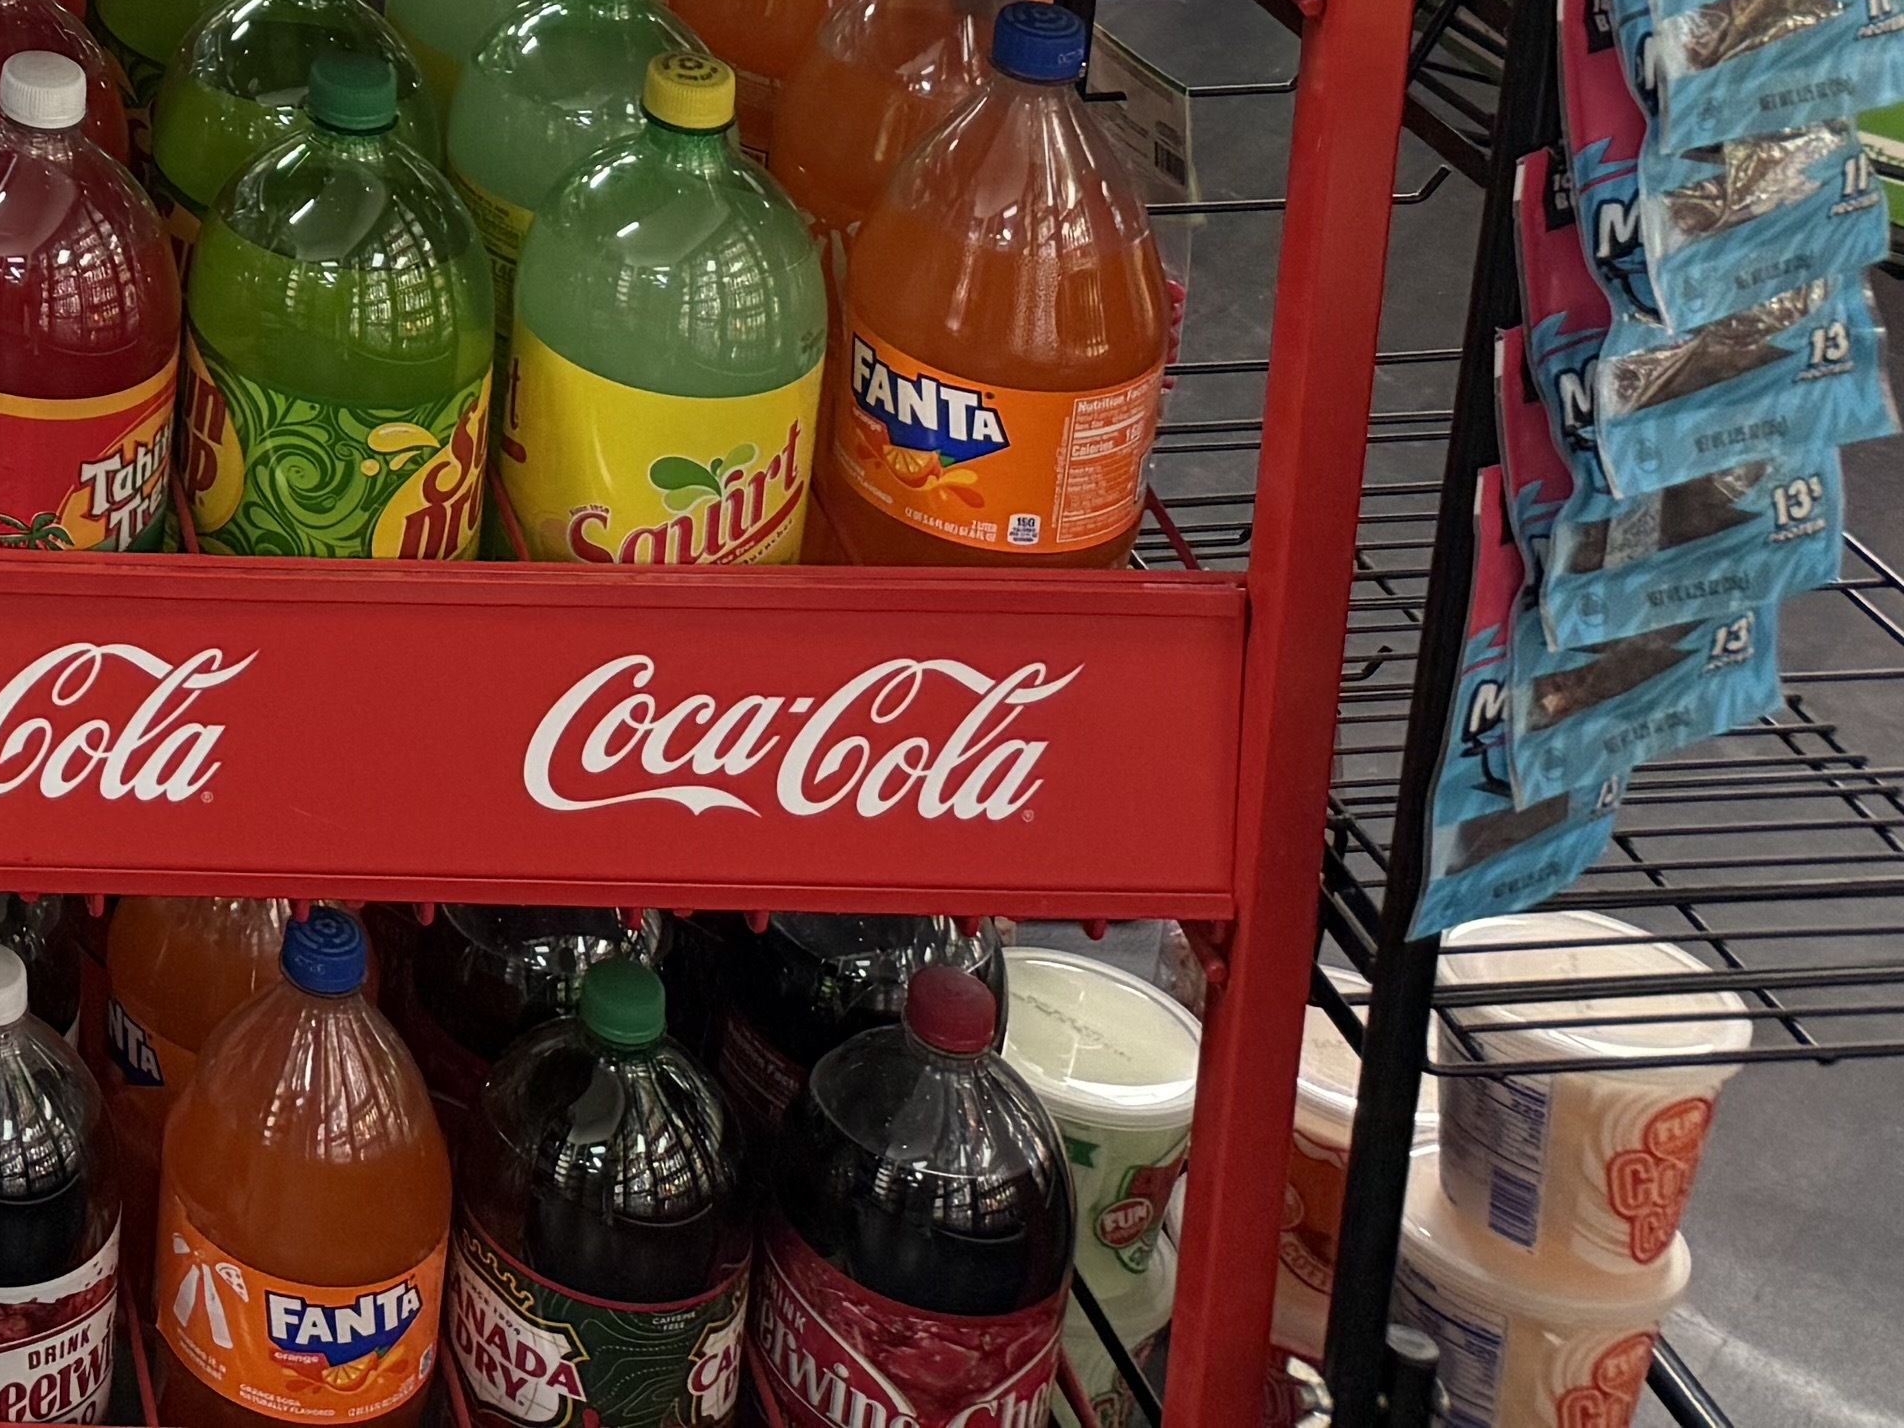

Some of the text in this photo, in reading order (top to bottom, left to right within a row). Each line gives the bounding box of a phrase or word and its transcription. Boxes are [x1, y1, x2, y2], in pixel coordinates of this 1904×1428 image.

[852, 336, 1007, 444] FANTA
[568, 415, 803, 564] Squirt
[523, 654, 1085, 821] Coca-Cola
[1103, 1202, 1150, 1239] FUN
[268, 1282, 422, 1346] FANTA
[27, 1330, 92, 1372] DRINK
[275, 1350, 320, 1365] orange
